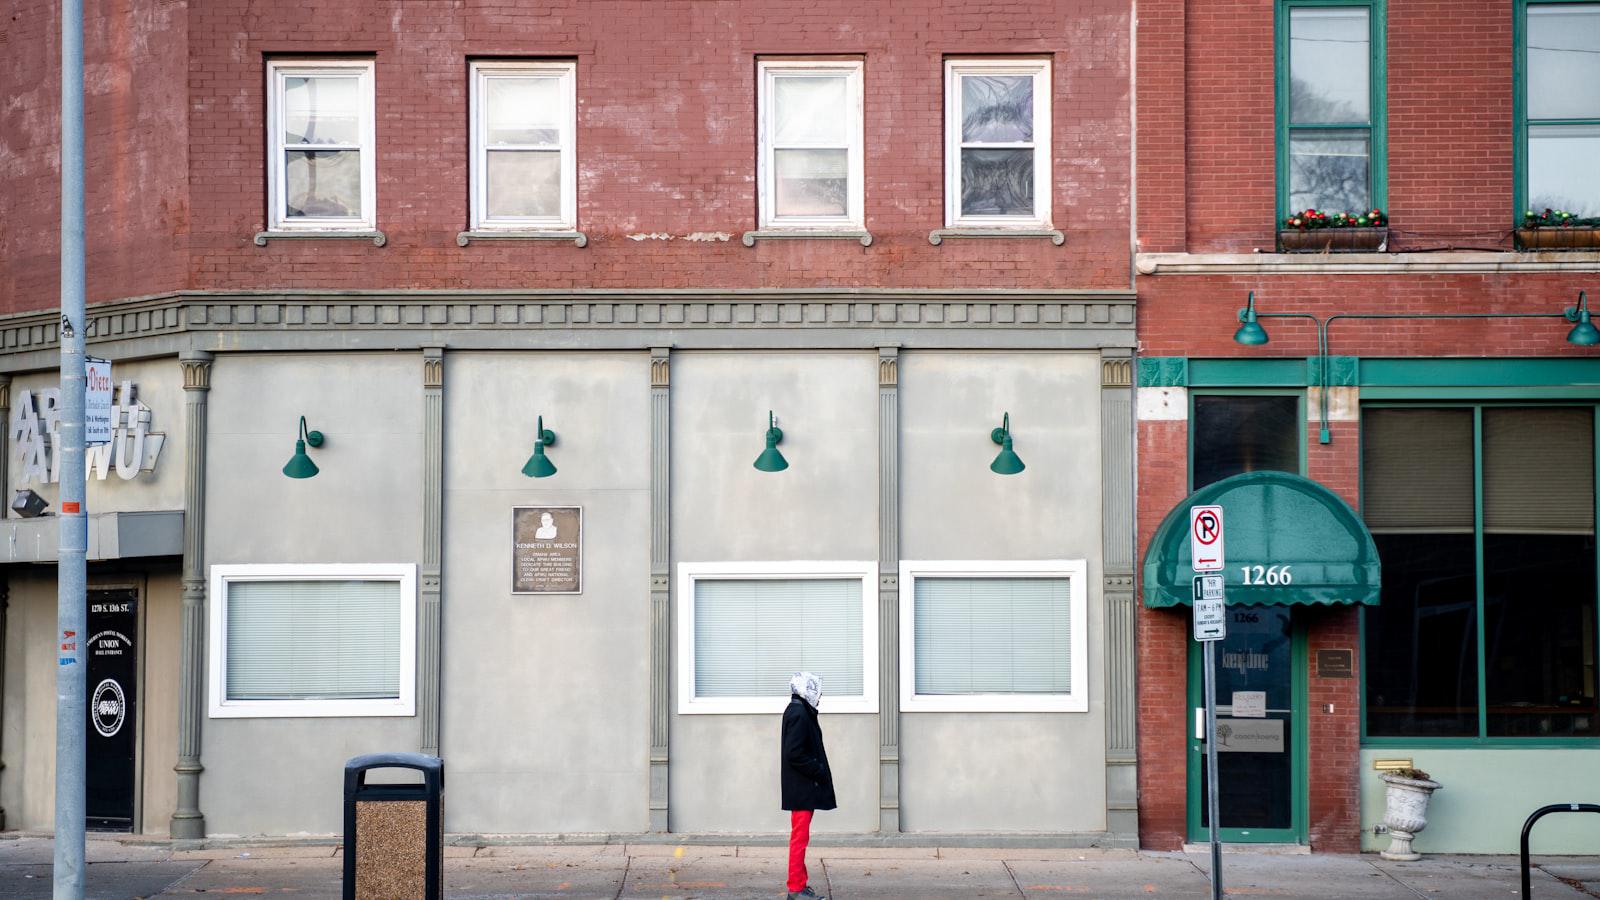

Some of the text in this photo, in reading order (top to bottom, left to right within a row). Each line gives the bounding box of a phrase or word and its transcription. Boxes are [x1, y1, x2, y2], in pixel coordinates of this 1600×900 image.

[1241, 565, 1292, 585] 1266
[1196, 580, 1201, 598] 1
[91, 604, 102, 613] 1270
[1234, 613, 1259, 623] 1266
[99, 639, 120, 648] UNION
